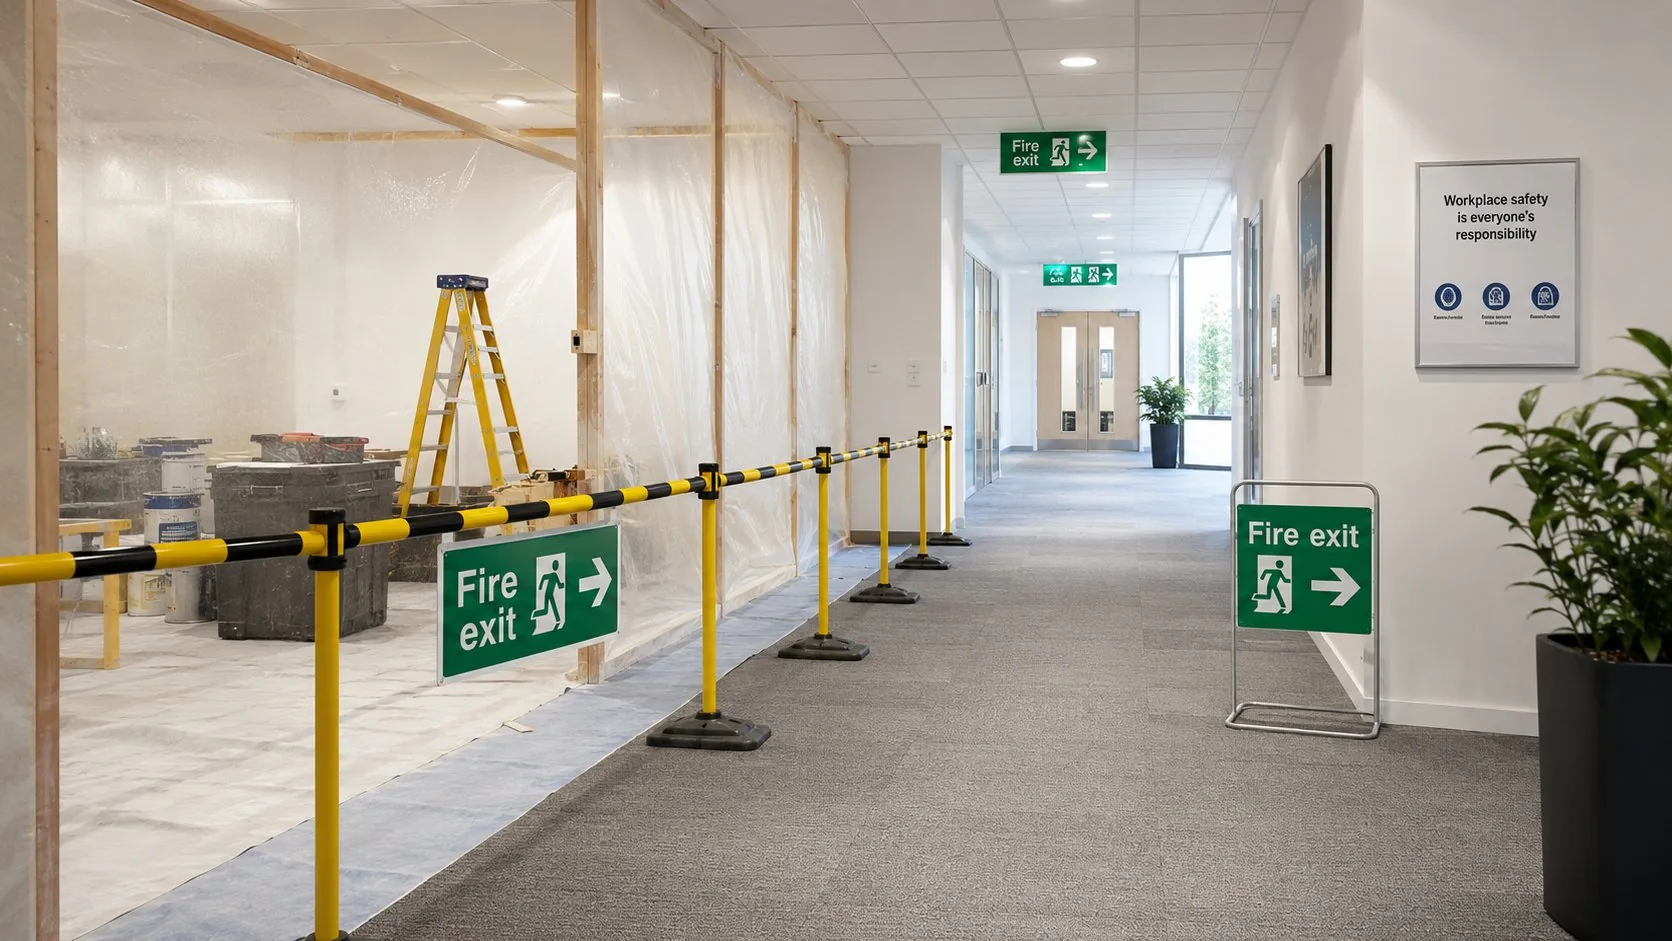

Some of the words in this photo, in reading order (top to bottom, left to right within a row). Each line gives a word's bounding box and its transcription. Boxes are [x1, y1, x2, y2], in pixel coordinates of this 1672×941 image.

[1012, 139, 1040, 152] Fire
[1013, 153, 1039, 167] exit
[1443, 193, 1508, 208] Workplace
[1510, 192, 1549, 208] safety
[1457, 211, 1468, 223] is
[1470, 210, 1535, 225] everyone's
[1455, 227, 1537, 242] responsibility
[1248, 521, 1299, 546] Fire
[1309, 523, 1360, 548] exit
[457, 567, 518, 608] Fire
[459, 606, 517, 651] exit
